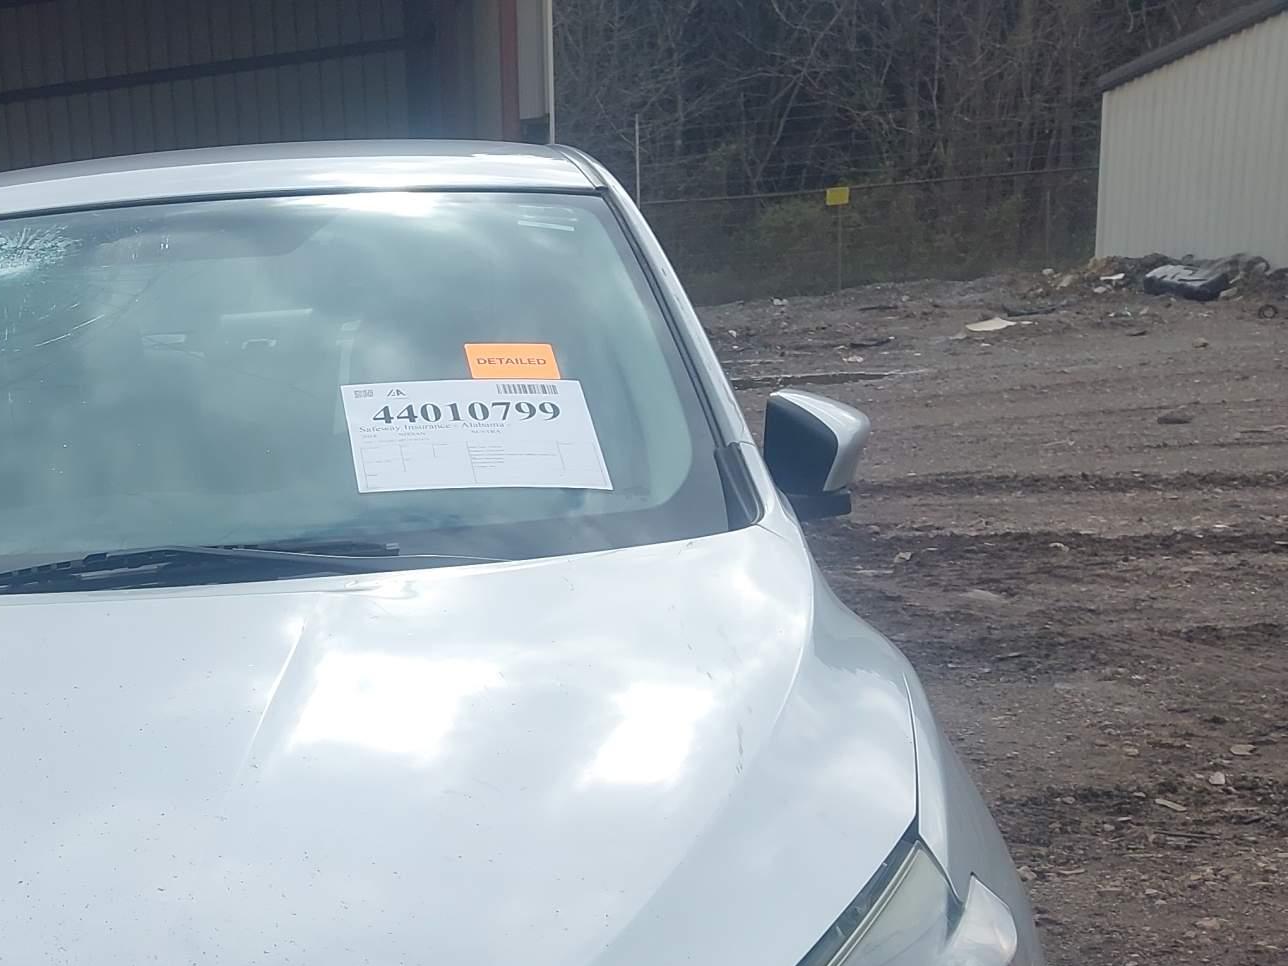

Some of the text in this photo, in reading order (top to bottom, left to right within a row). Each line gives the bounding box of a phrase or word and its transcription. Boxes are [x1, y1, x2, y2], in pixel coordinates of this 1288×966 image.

[476, 357, 547, 365] DETAILED
[372, 401, 561, 424] 44010799
[359, 425, 400, 433] Safeway
[404, 423, 451, 431] Insurance
